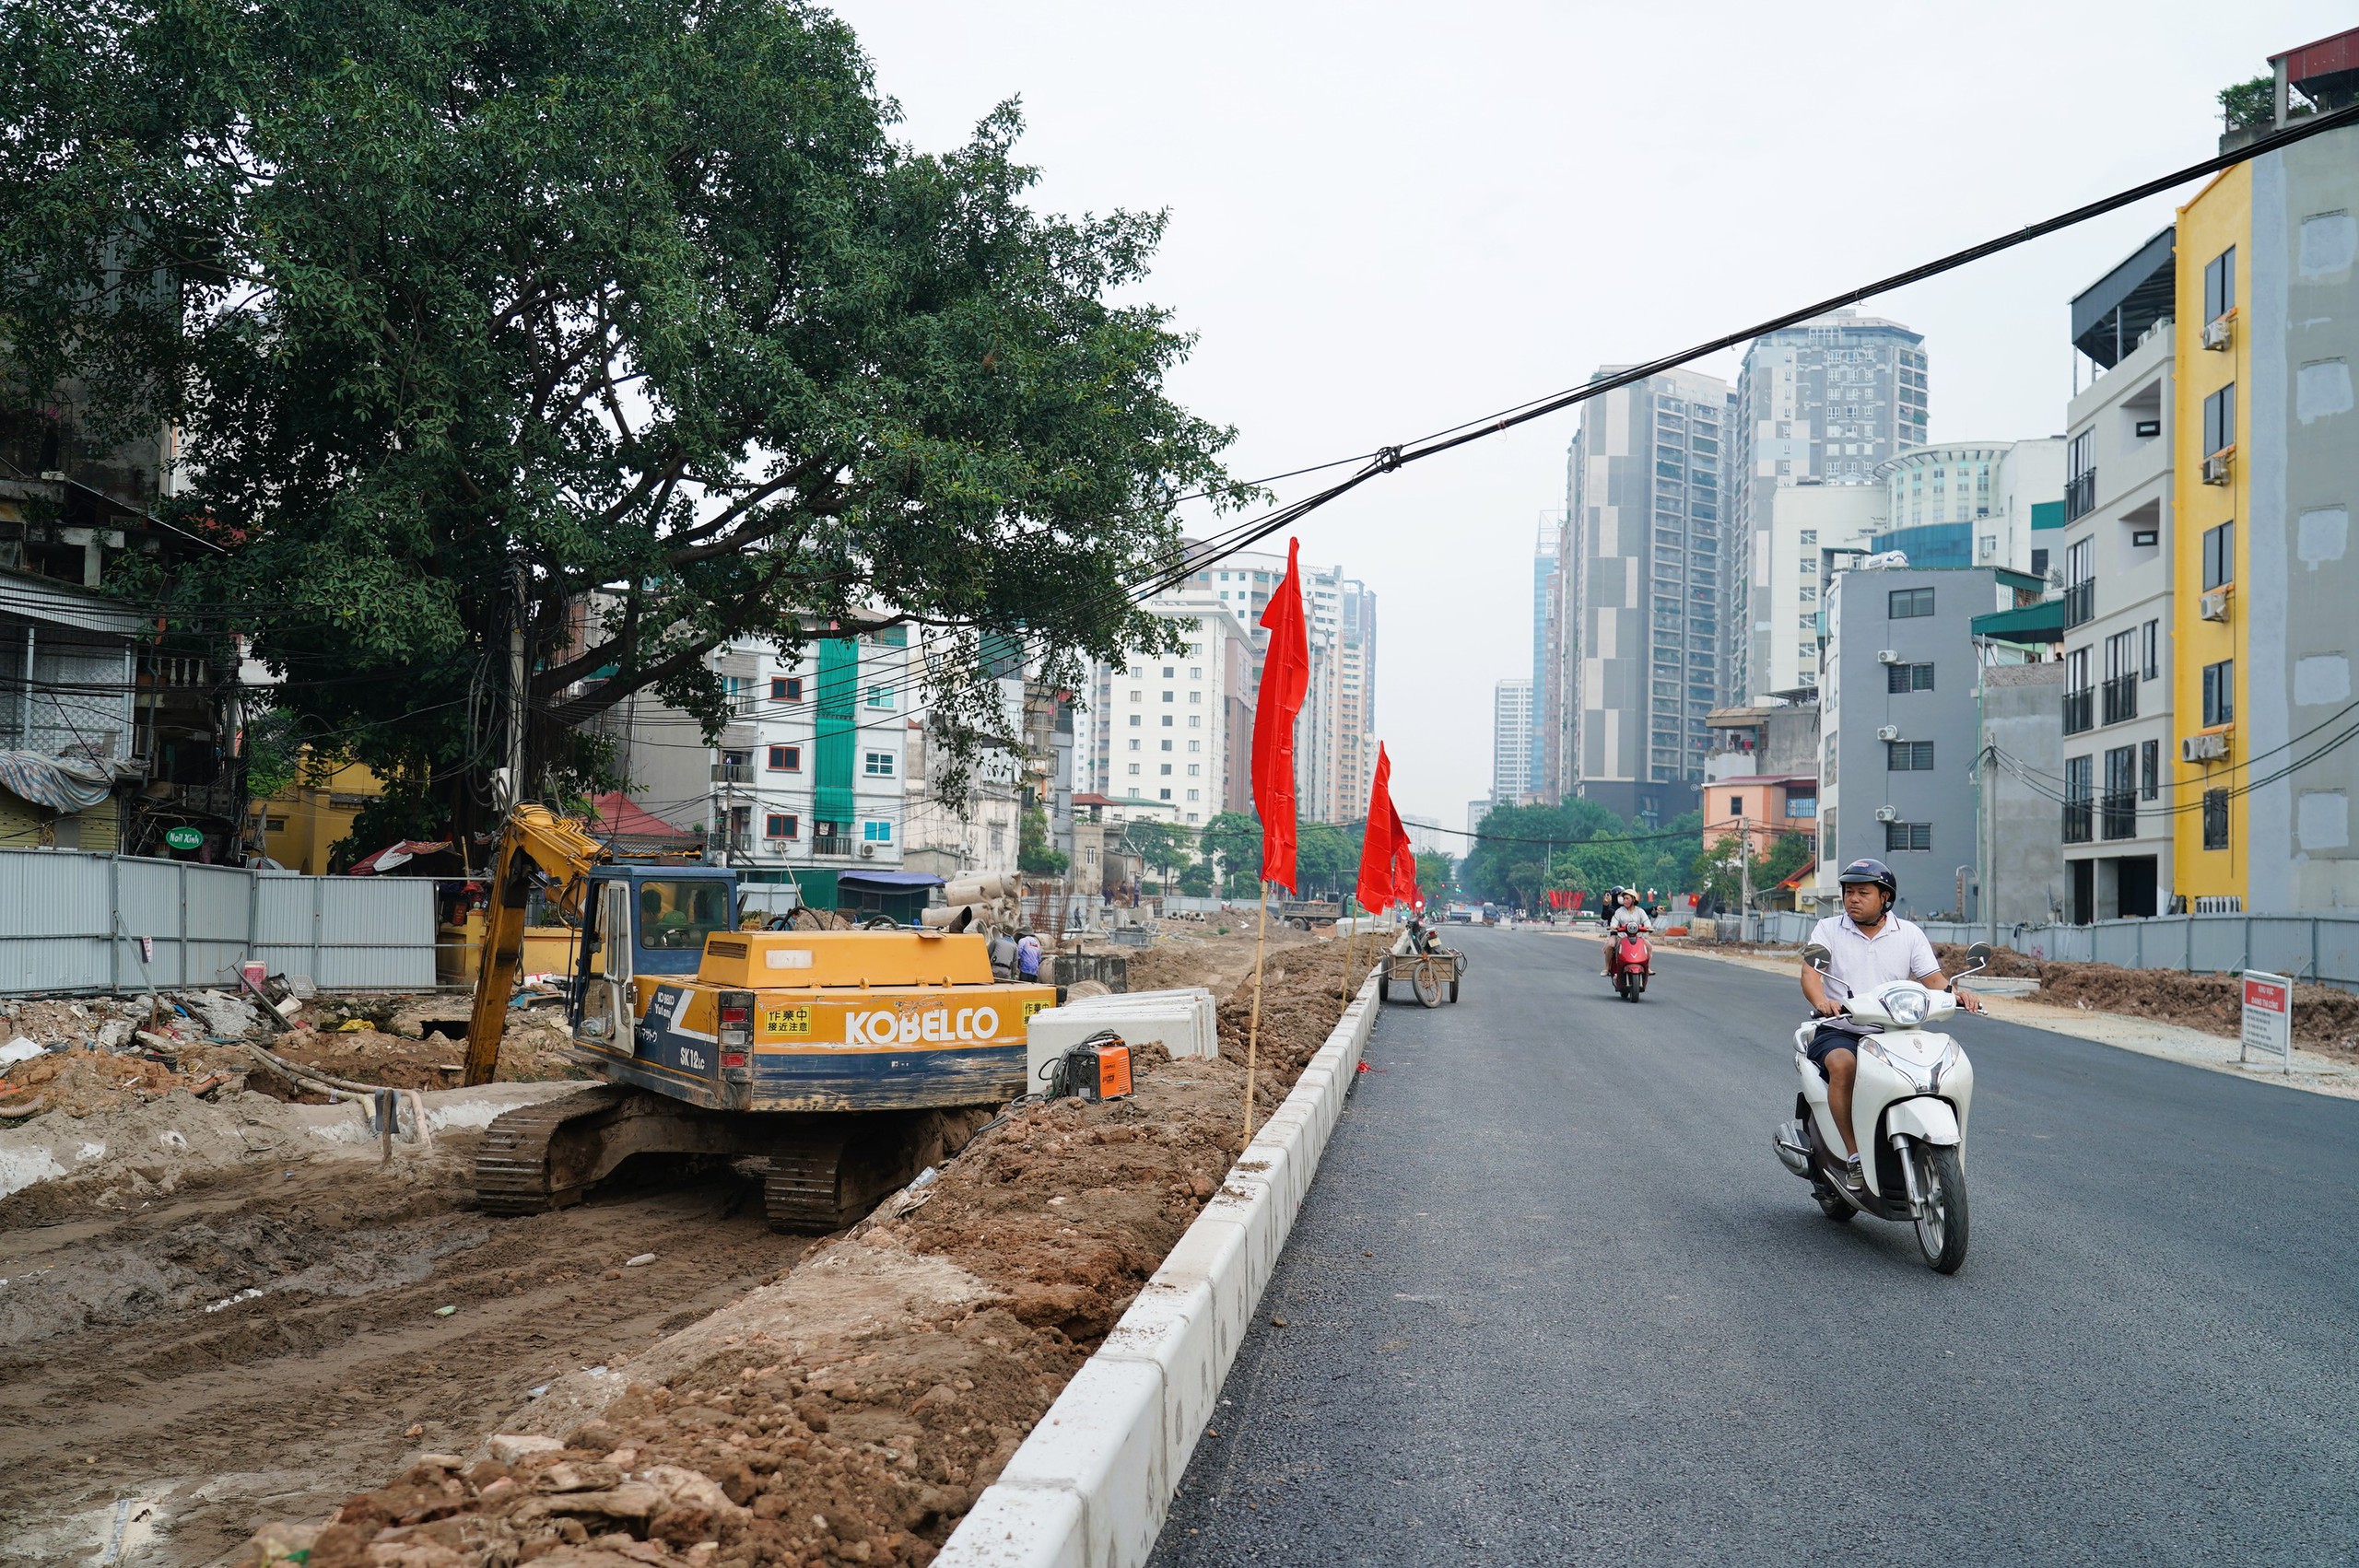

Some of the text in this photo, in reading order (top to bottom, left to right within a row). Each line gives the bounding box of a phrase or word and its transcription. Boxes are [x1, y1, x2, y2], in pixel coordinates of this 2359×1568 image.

[170, 832, 183, 842] Nail
[769, 1010, 807, 1021] 作業中
[768, 1022, 807, 1032] 接近注意
[845, 1006, 999, 1044] KOBELCO
